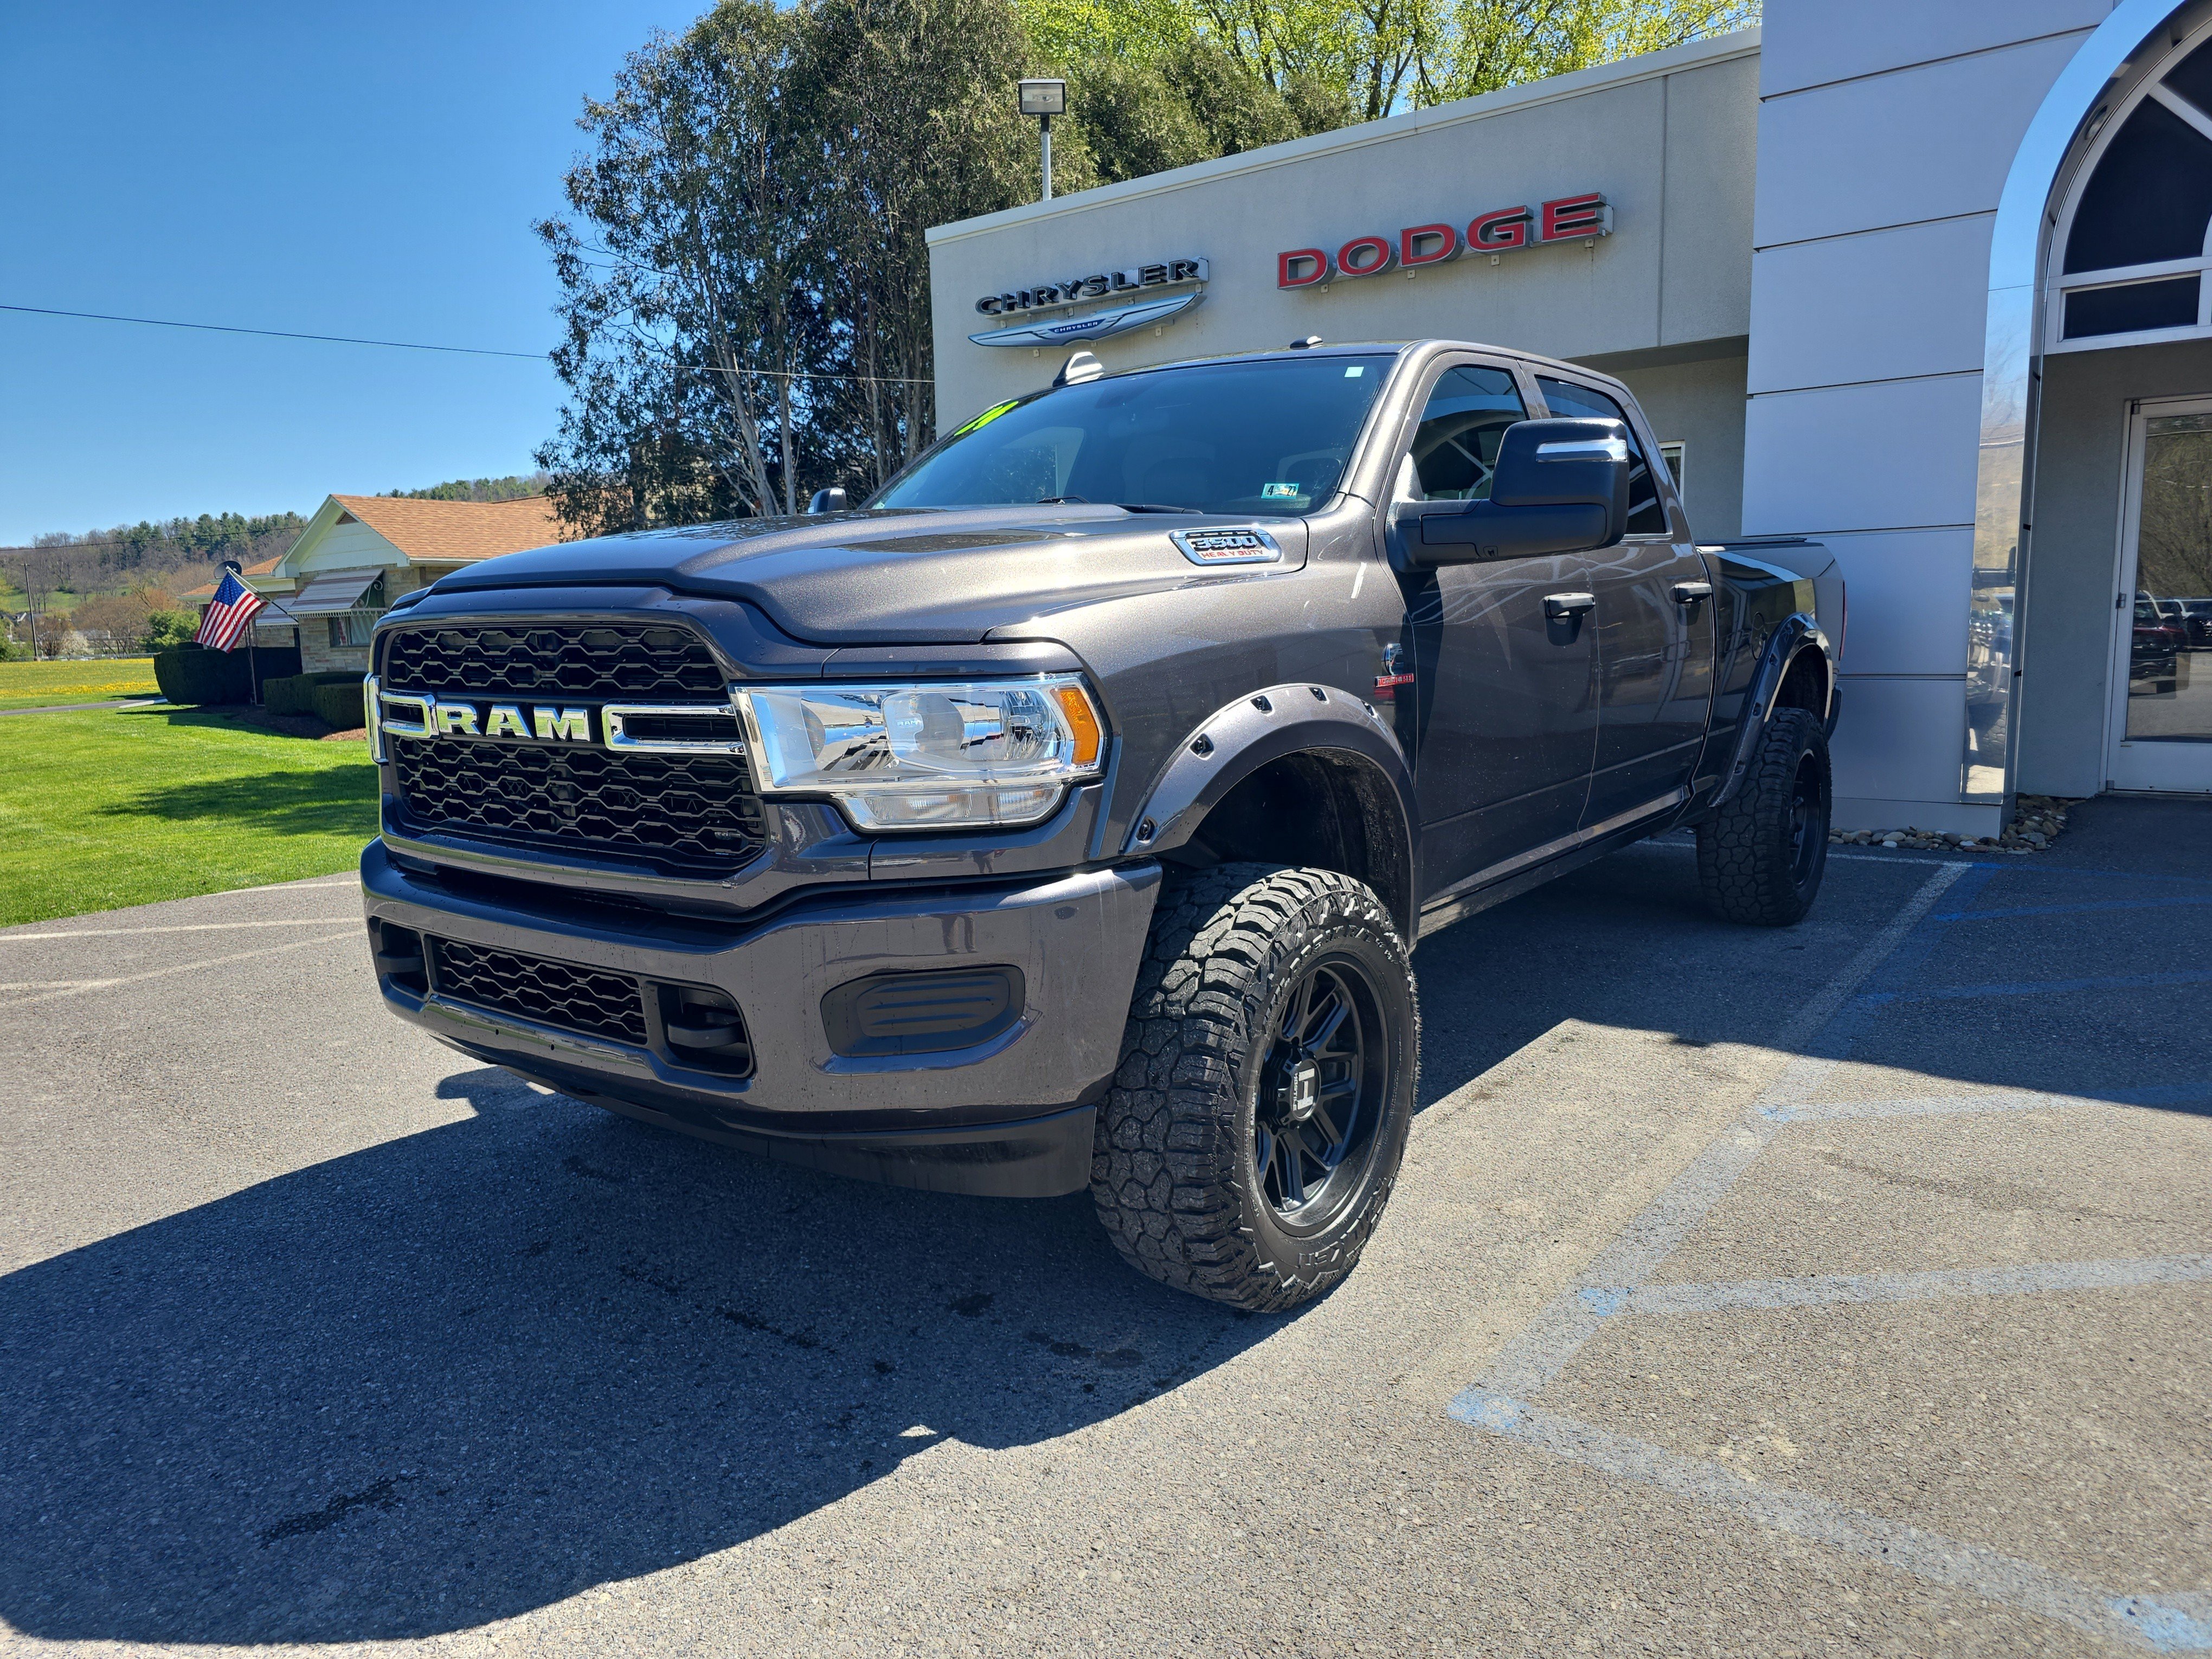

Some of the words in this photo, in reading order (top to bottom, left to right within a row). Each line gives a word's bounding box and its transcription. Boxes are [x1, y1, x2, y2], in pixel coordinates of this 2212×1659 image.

[1277, 192, 1607, 292] DODGE
[975, 259, 1199, 316] CHRYSLER
[1054, 321, 1098, 333] CHRYSLER
[1267, 485, 1275, 496] 4
[1287, 486, 1296, 497] 27
[1193, 536, 1258, 551] 3500
[436, 702, 591, 742] RAM
